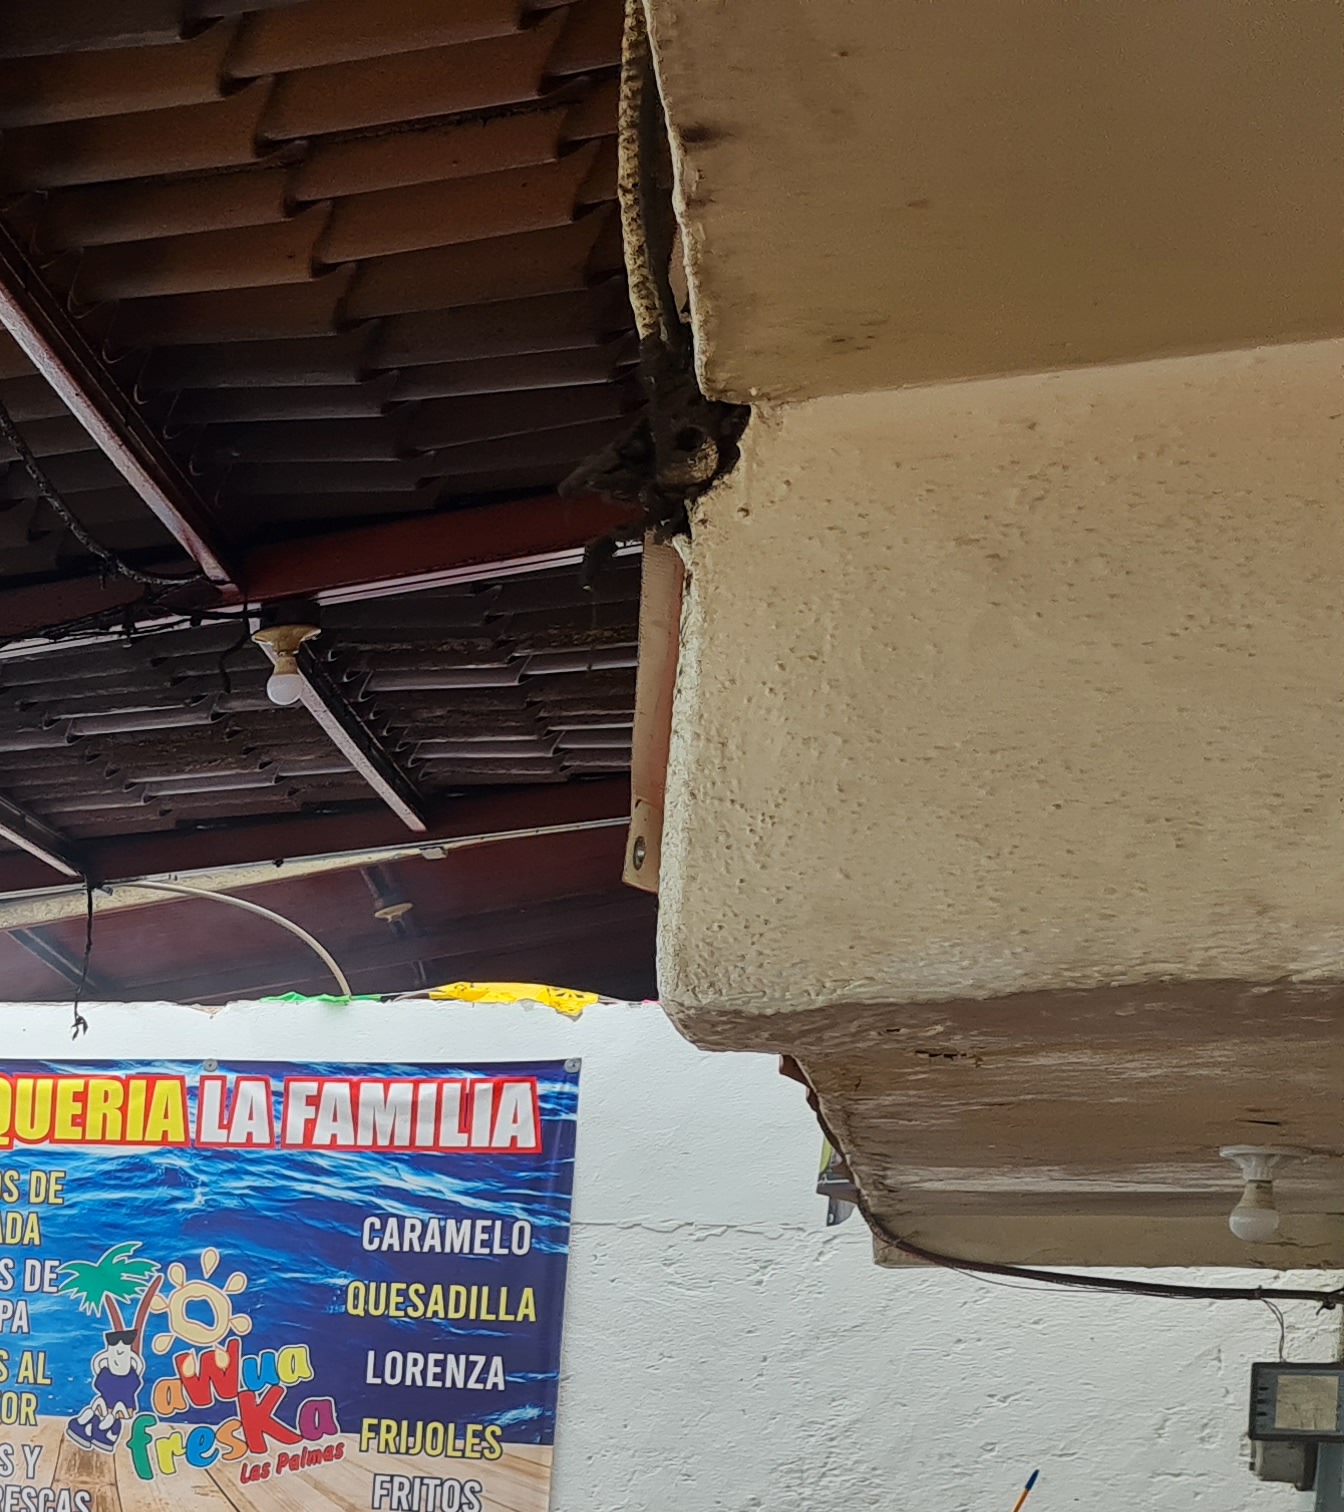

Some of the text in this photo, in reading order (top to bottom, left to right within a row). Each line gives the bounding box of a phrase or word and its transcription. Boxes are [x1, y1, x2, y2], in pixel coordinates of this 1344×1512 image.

[198, 1077, 272, 1144] LA
[284, 1080, 539, 1149] FAMILIA
[28, 1170, 66, 1205] DE
[362, 1216, 532, 1256] CARAMELO
[23, 1258, 61, 1293] DE
[346, 1280, 537, 1322] QUESADILLA
[15, 1349, 52, 1385] AL
[365, 1350, 506, 1391] LORENZA
[359, 1418, 503, 1461] FRIJOLES
[21, 1444, 43, 1479] Y
[240, 1442, 345, 1484] Las Palmas
